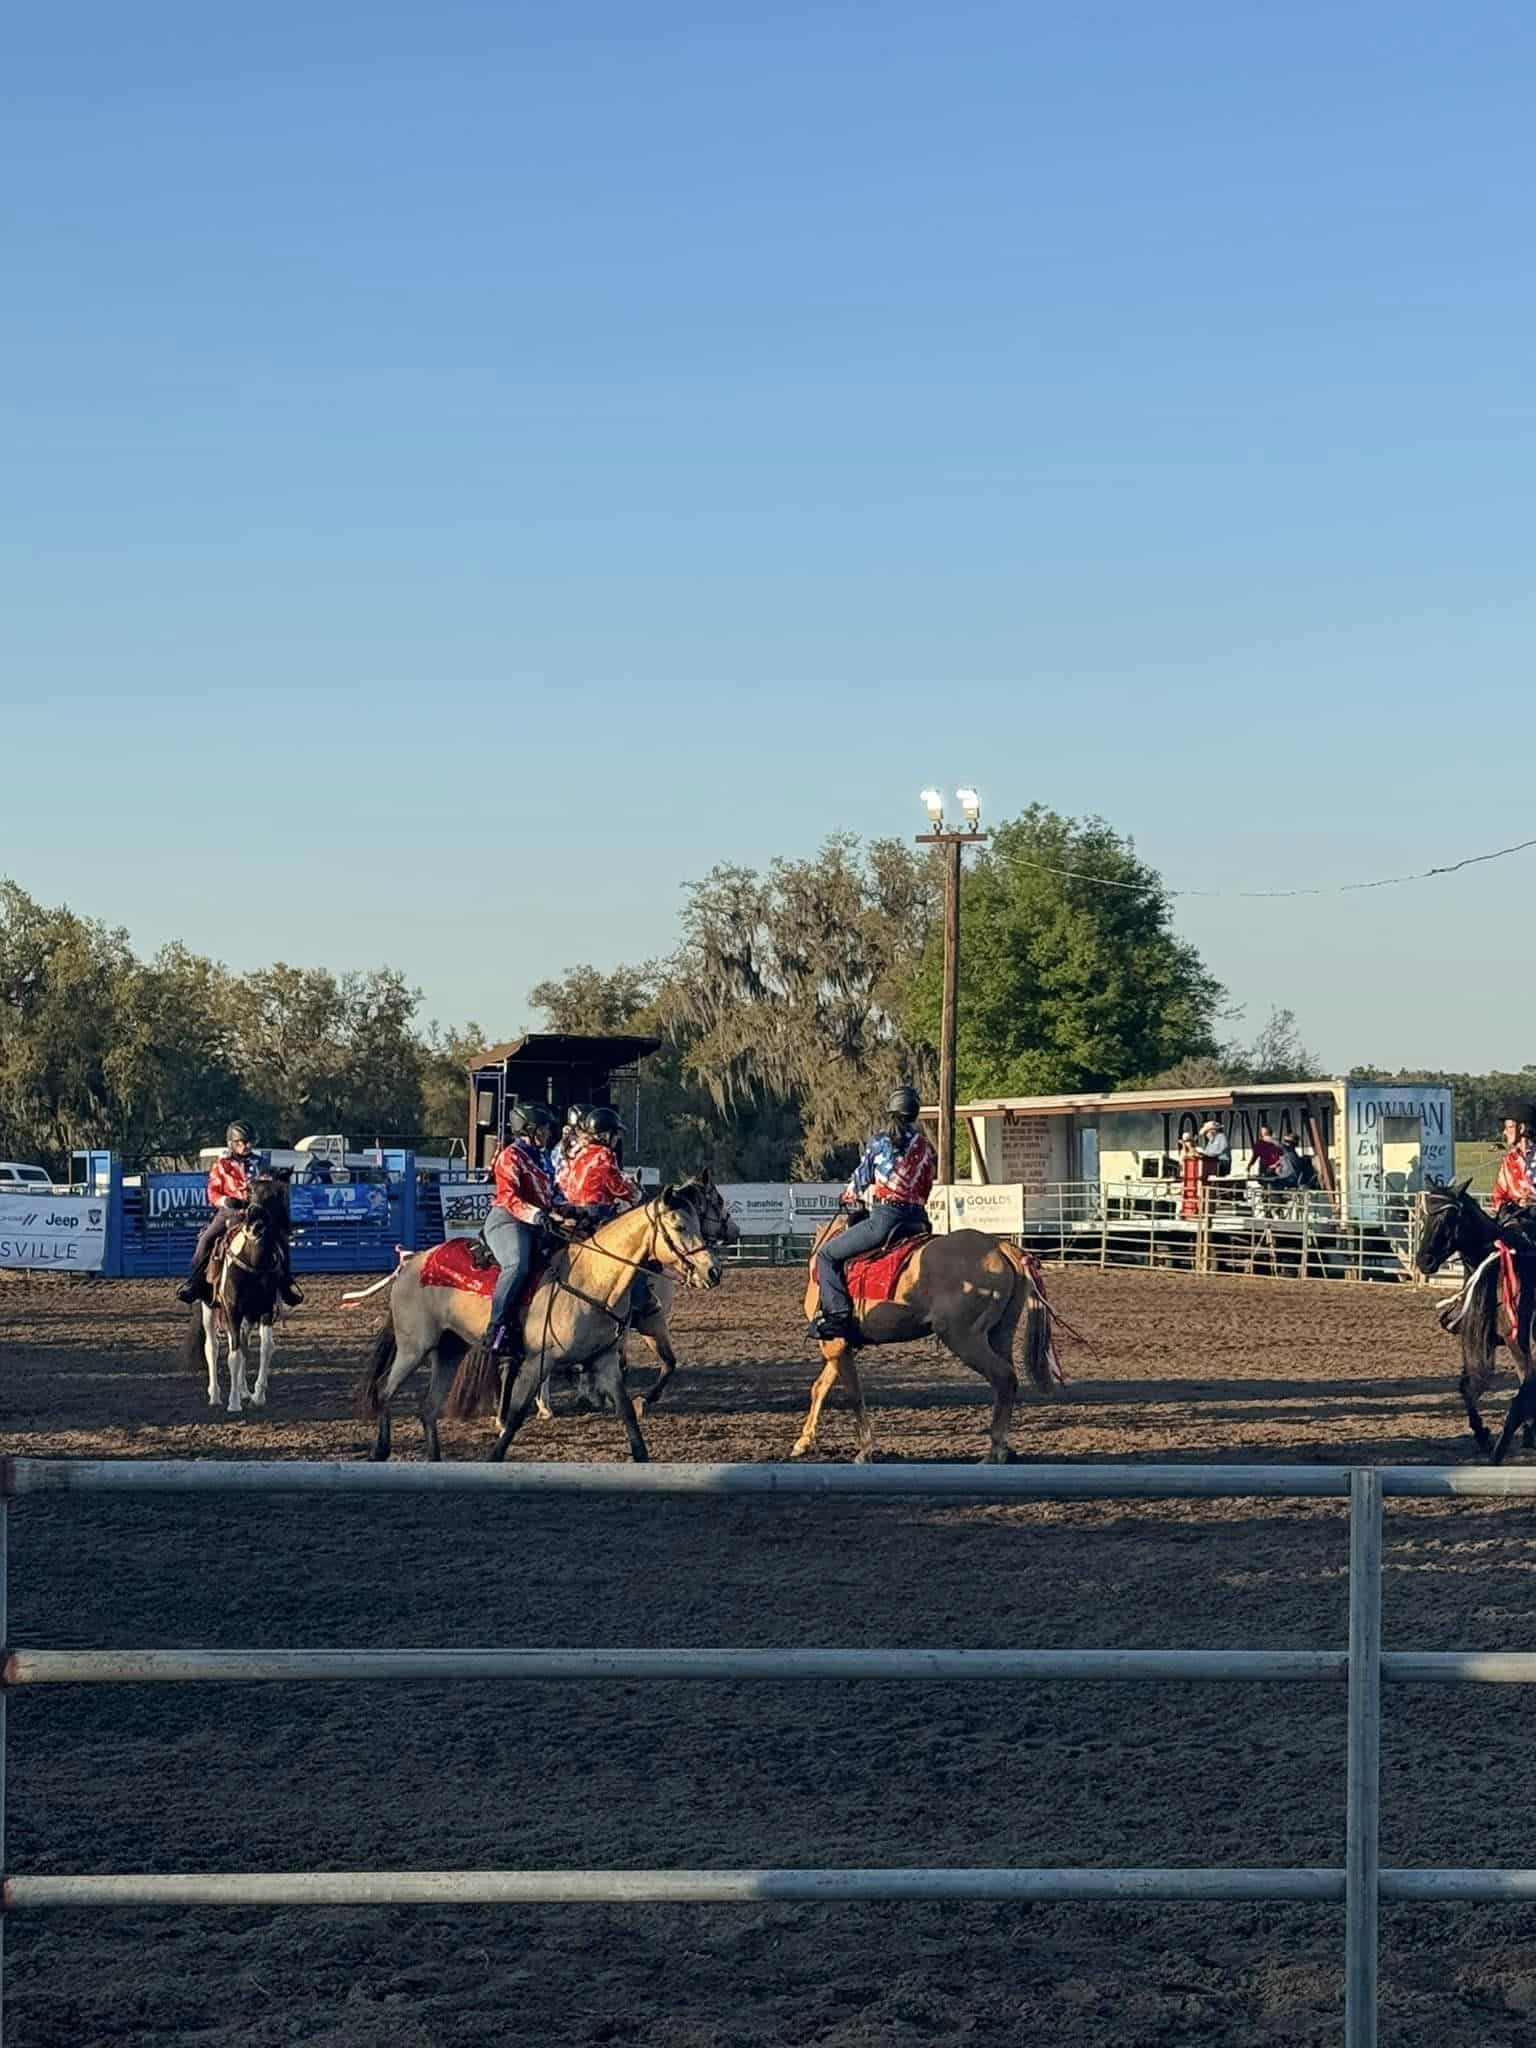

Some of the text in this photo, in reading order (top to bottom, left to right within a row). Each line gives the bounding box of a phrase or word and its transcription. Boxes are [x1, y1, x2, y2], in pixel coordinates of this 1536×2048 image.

[149, 1187, 213, 1217] LOWM
[746, 1200, 783, 1208] Sunshine
[795, 1197, 818, 1208] BEEF
[966, 1195, 1013, 1206] GOULDS
[45, 1212, 79, 1228] Jeep
[0, 1241, 79, 1260] SVILLE
